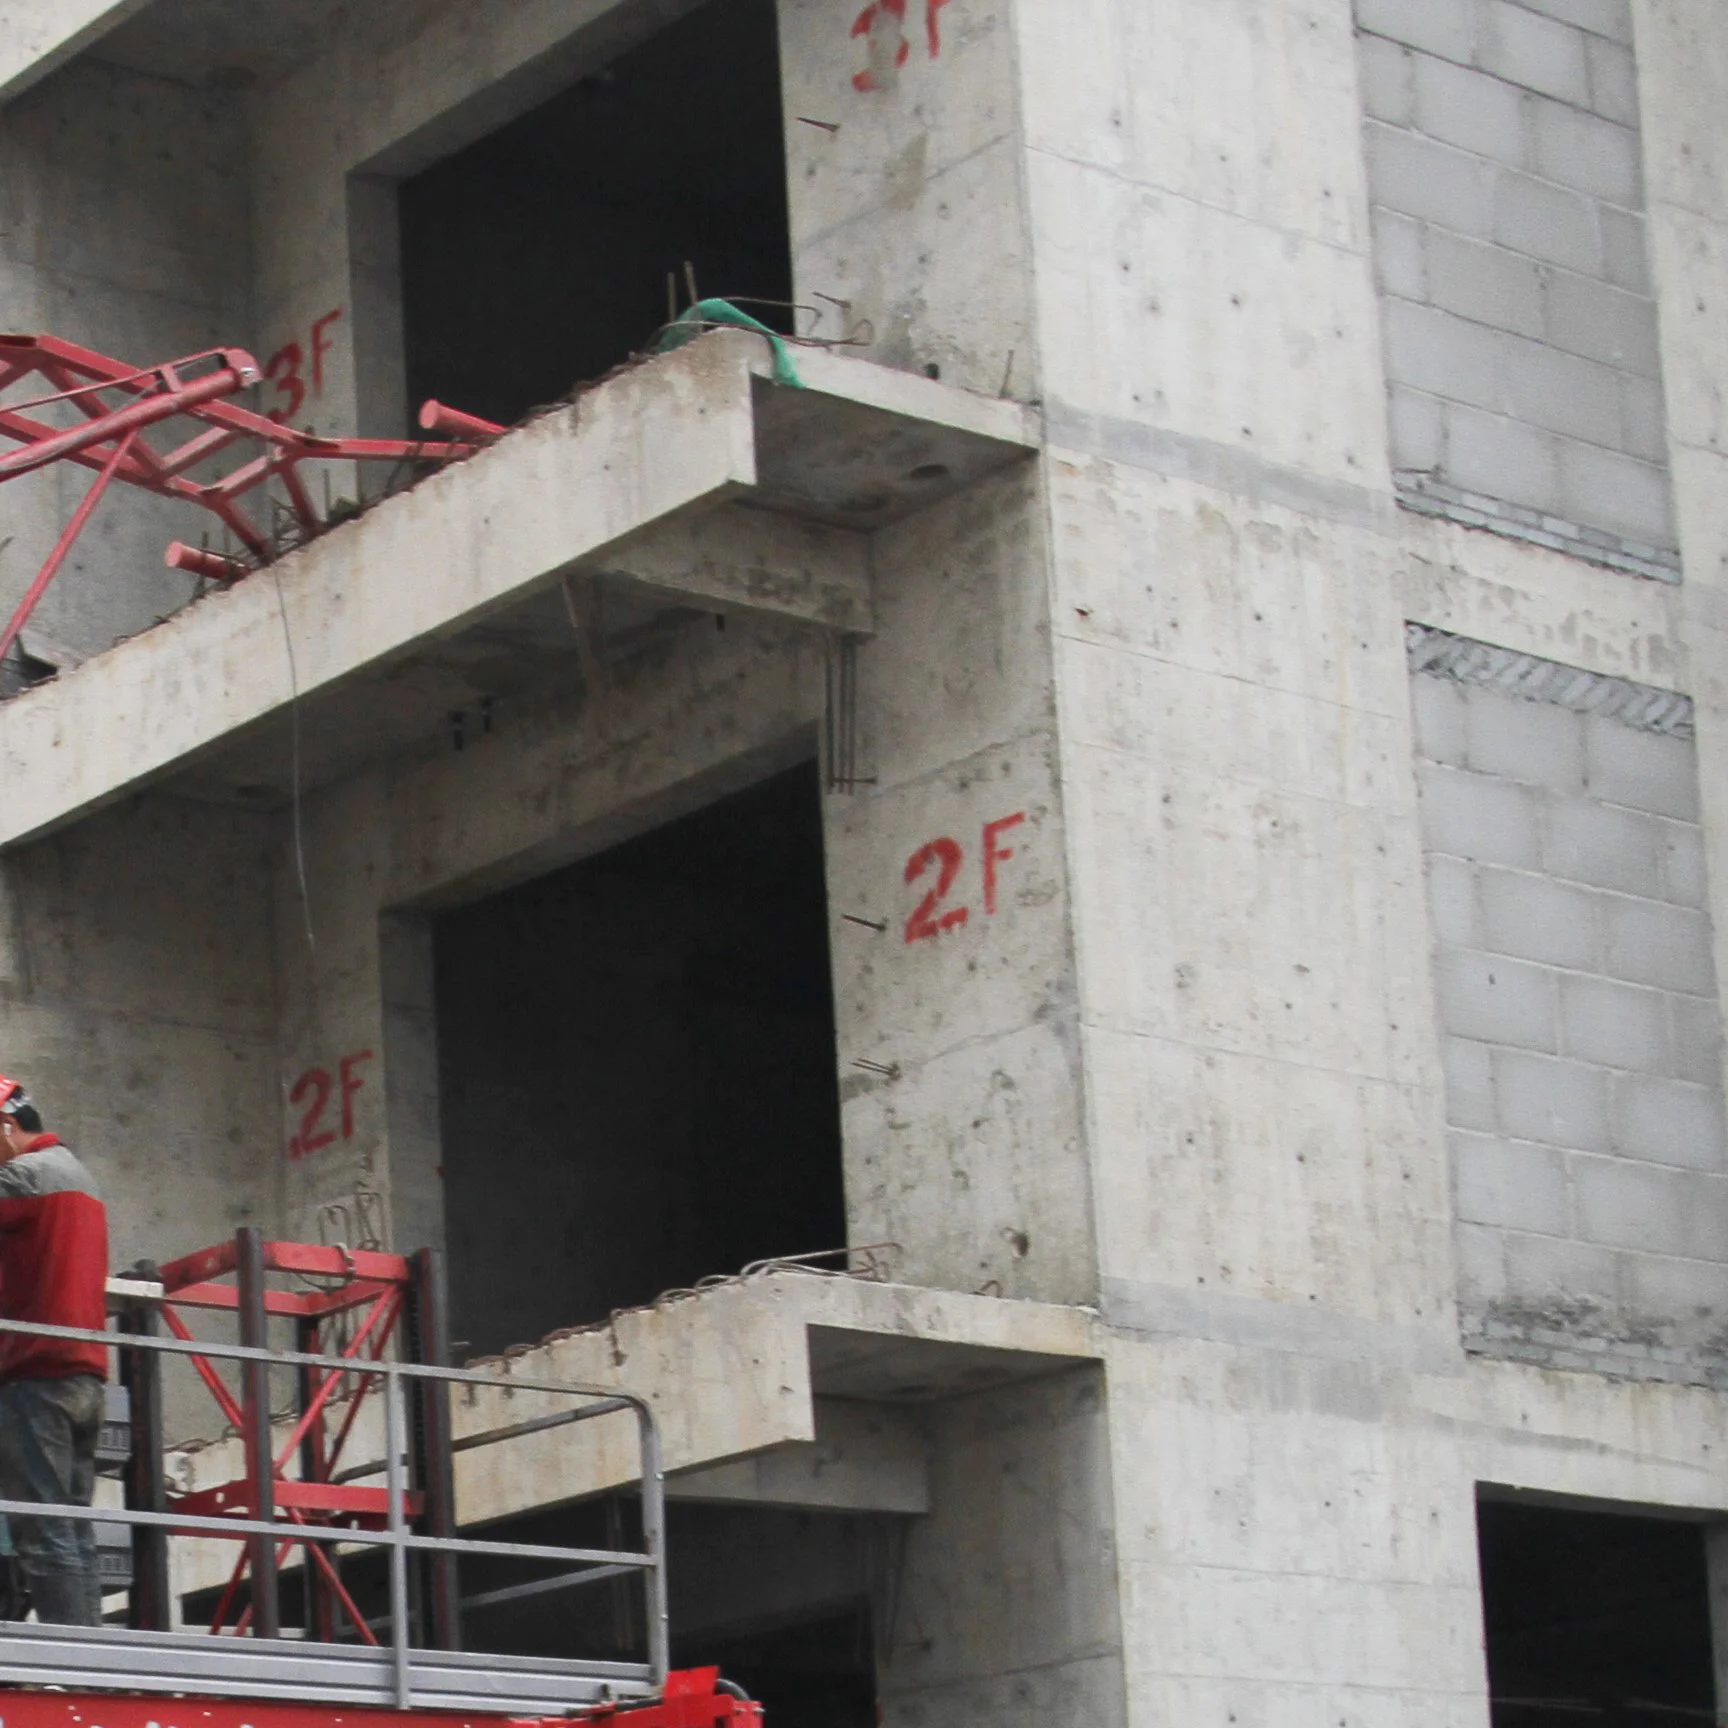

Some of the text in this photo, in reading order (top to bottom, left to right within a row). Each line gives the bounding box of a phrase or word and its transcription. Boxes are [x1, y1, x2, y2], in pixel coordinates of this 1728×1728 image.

[265, 304, 344, 425] 3F
[904, 811, 1026, 945] 2F
[288, 1048, 375, 1161] 2F
